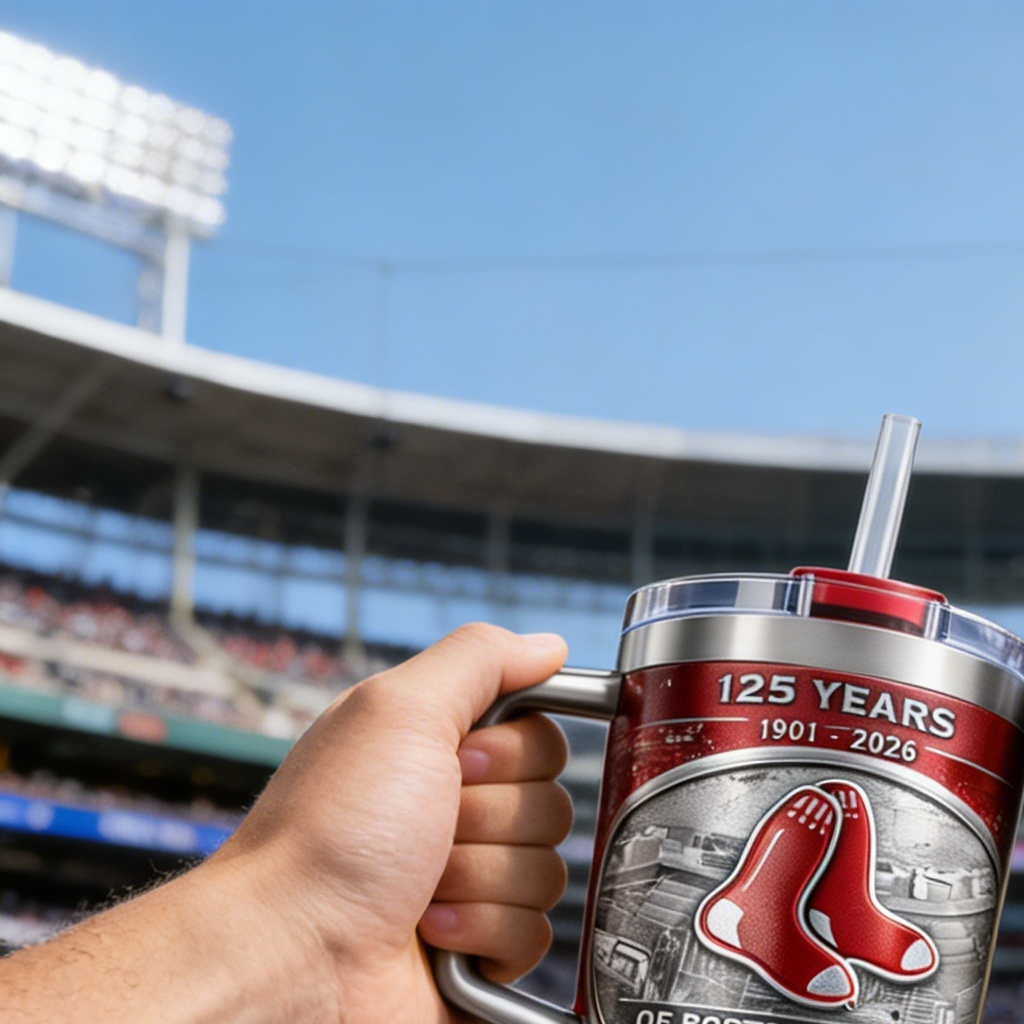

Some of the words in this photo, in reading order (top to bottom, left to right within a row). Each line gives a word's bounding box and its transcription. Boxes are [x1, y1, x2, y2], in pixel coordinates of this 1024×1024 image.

[718, 674, 797, 705] 125
[813, 679, 957, 740] YEARS
[760, 718, 817, 743] 1901
[850, 728, 918, 762] 2026
